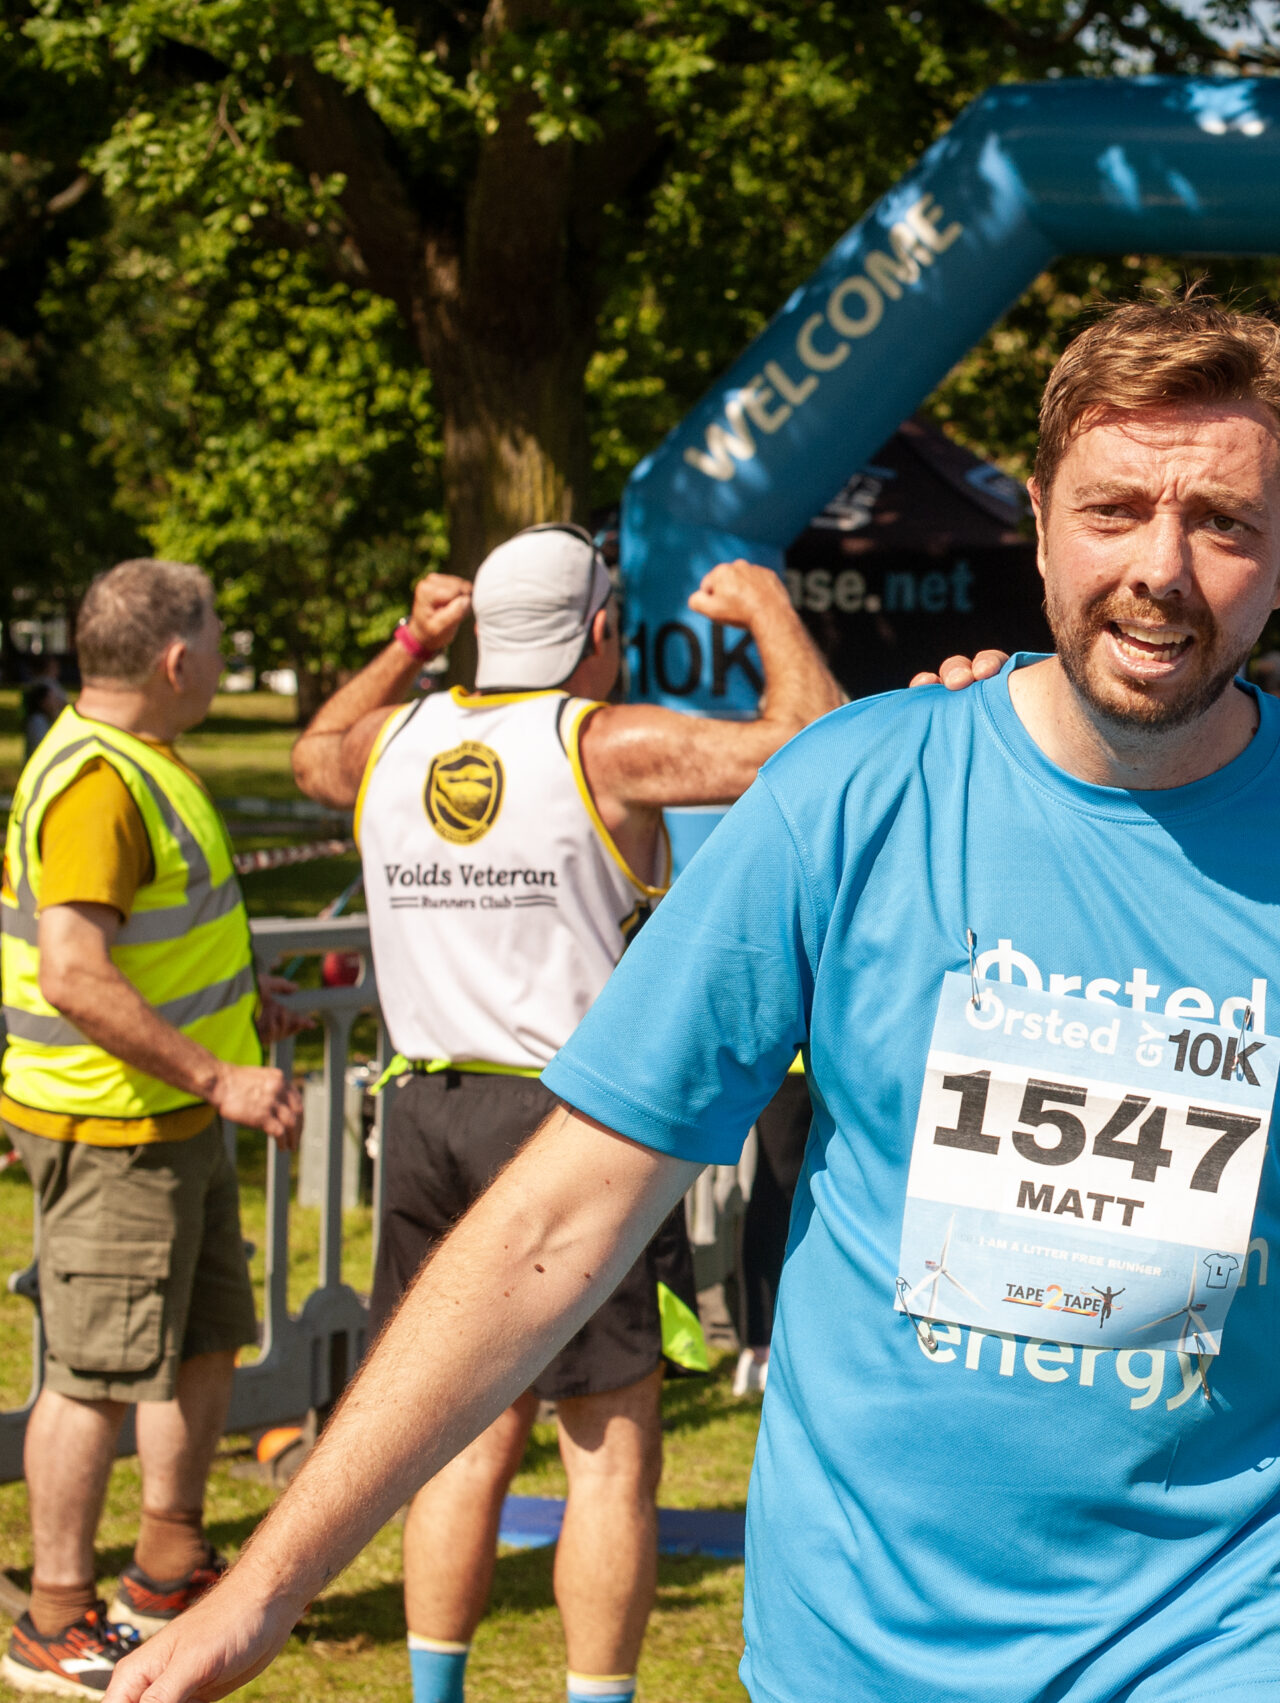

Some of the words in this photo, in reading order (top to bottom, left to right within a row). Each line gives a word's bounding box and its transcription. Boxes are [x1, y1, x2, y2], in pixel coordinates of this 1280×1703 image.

[683, 194, 963, 481] WELCOME
[628, 619, 766, 698] 10K
[385, 862, 452, 887] Volds
[459, 863, 558, 888] Veteran
[421, 893, 476, 909] Runners
[480, 894, 512, 909] Club
[965, 988, 1121, 1055] Ørsted
[1135, 1018, 1166, 1068] GY
[1168, 1029, 1267, 1087] 10K
[933, 1069, 1262, 1194] 1547
[1016, 1180, 1145, 1227] MATT
[1011, 1242, 1021, 1252] A
[1023, 1243, 1068, 1262] LITTER
[1071, 1252, 1104, 1268] FREE
[1107, 1259, 1163, 1277] RUNNER
[1216, 1266, 1223, 1277] L
[917, 1317, 1215, 1412] energy
